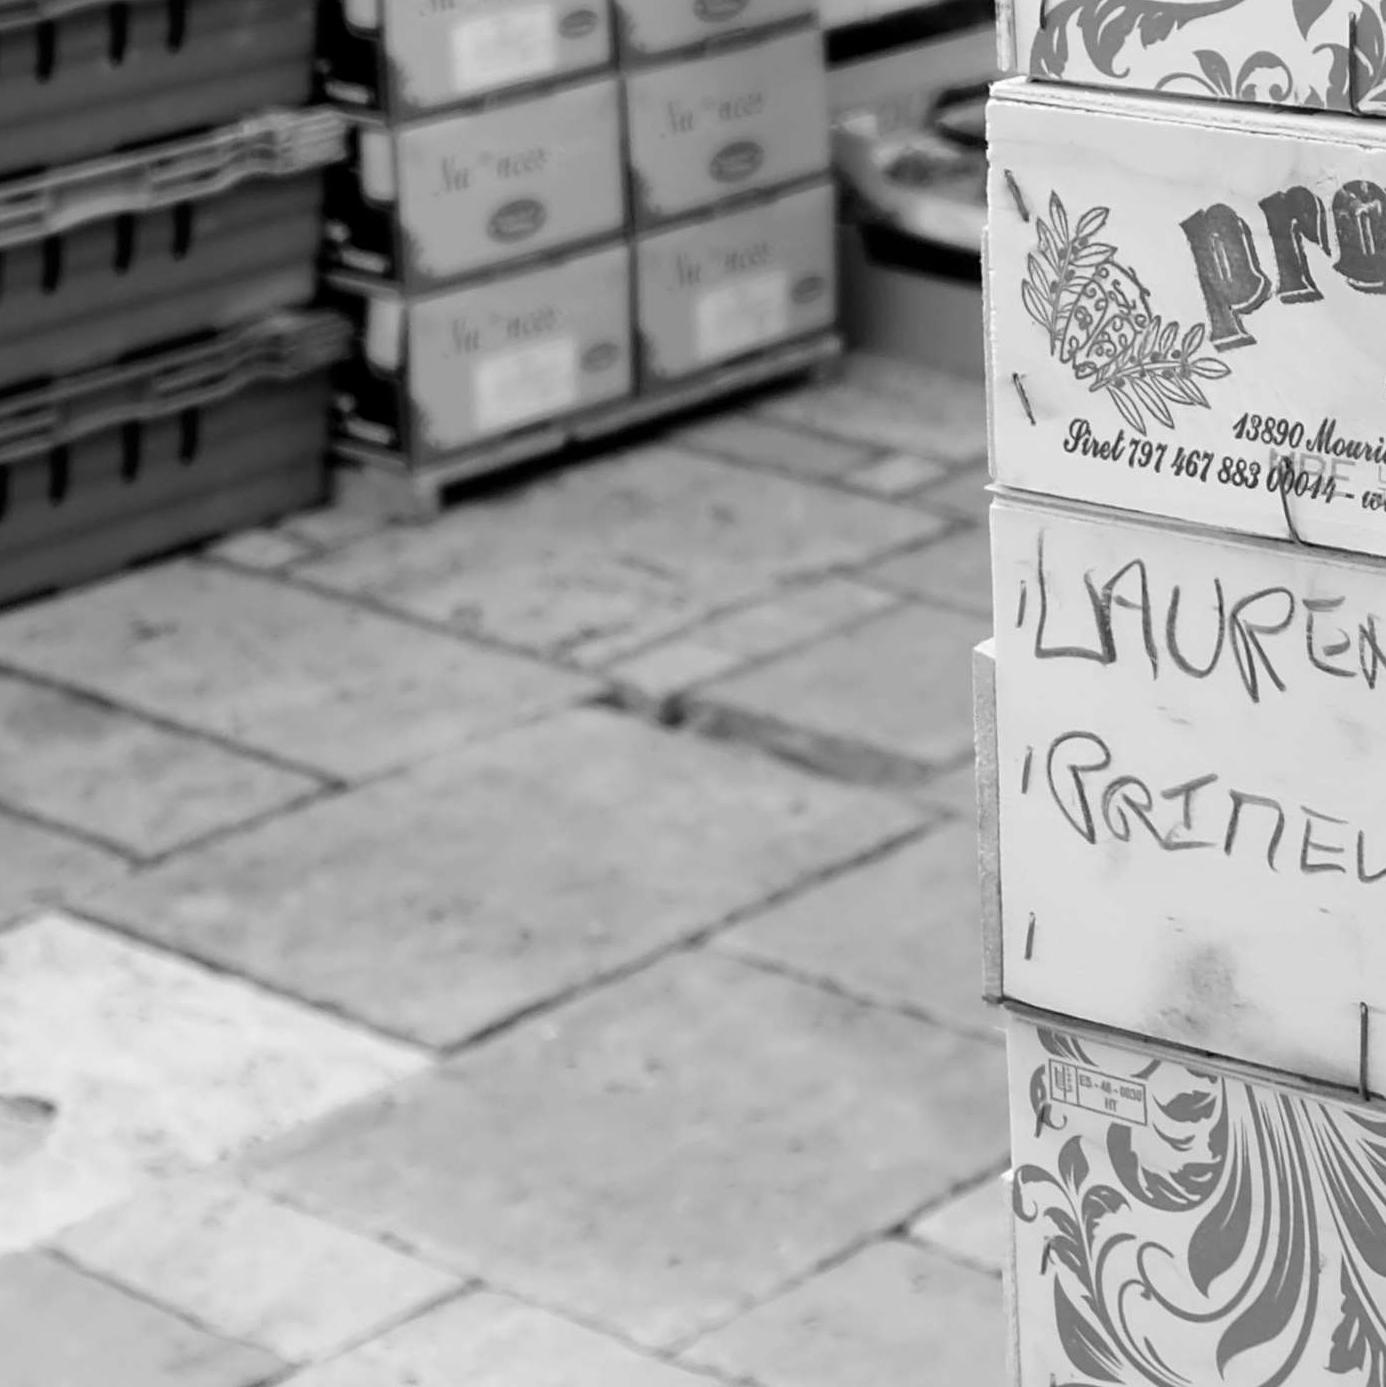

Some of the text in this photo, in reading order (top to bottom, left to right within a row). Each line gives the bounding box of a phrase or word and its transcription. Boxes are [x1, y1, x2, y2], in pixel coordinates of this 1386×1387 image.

[1064, 417, 1125, 463] Siret
[1127, 435, 1169, 469] 797
[1171, 445, 1214, 478] 467
[1216, 452, 1262, 487] 883
[1266, 462, 1337, 503] 00014
[1232, 411, 1304, 450] 13890
